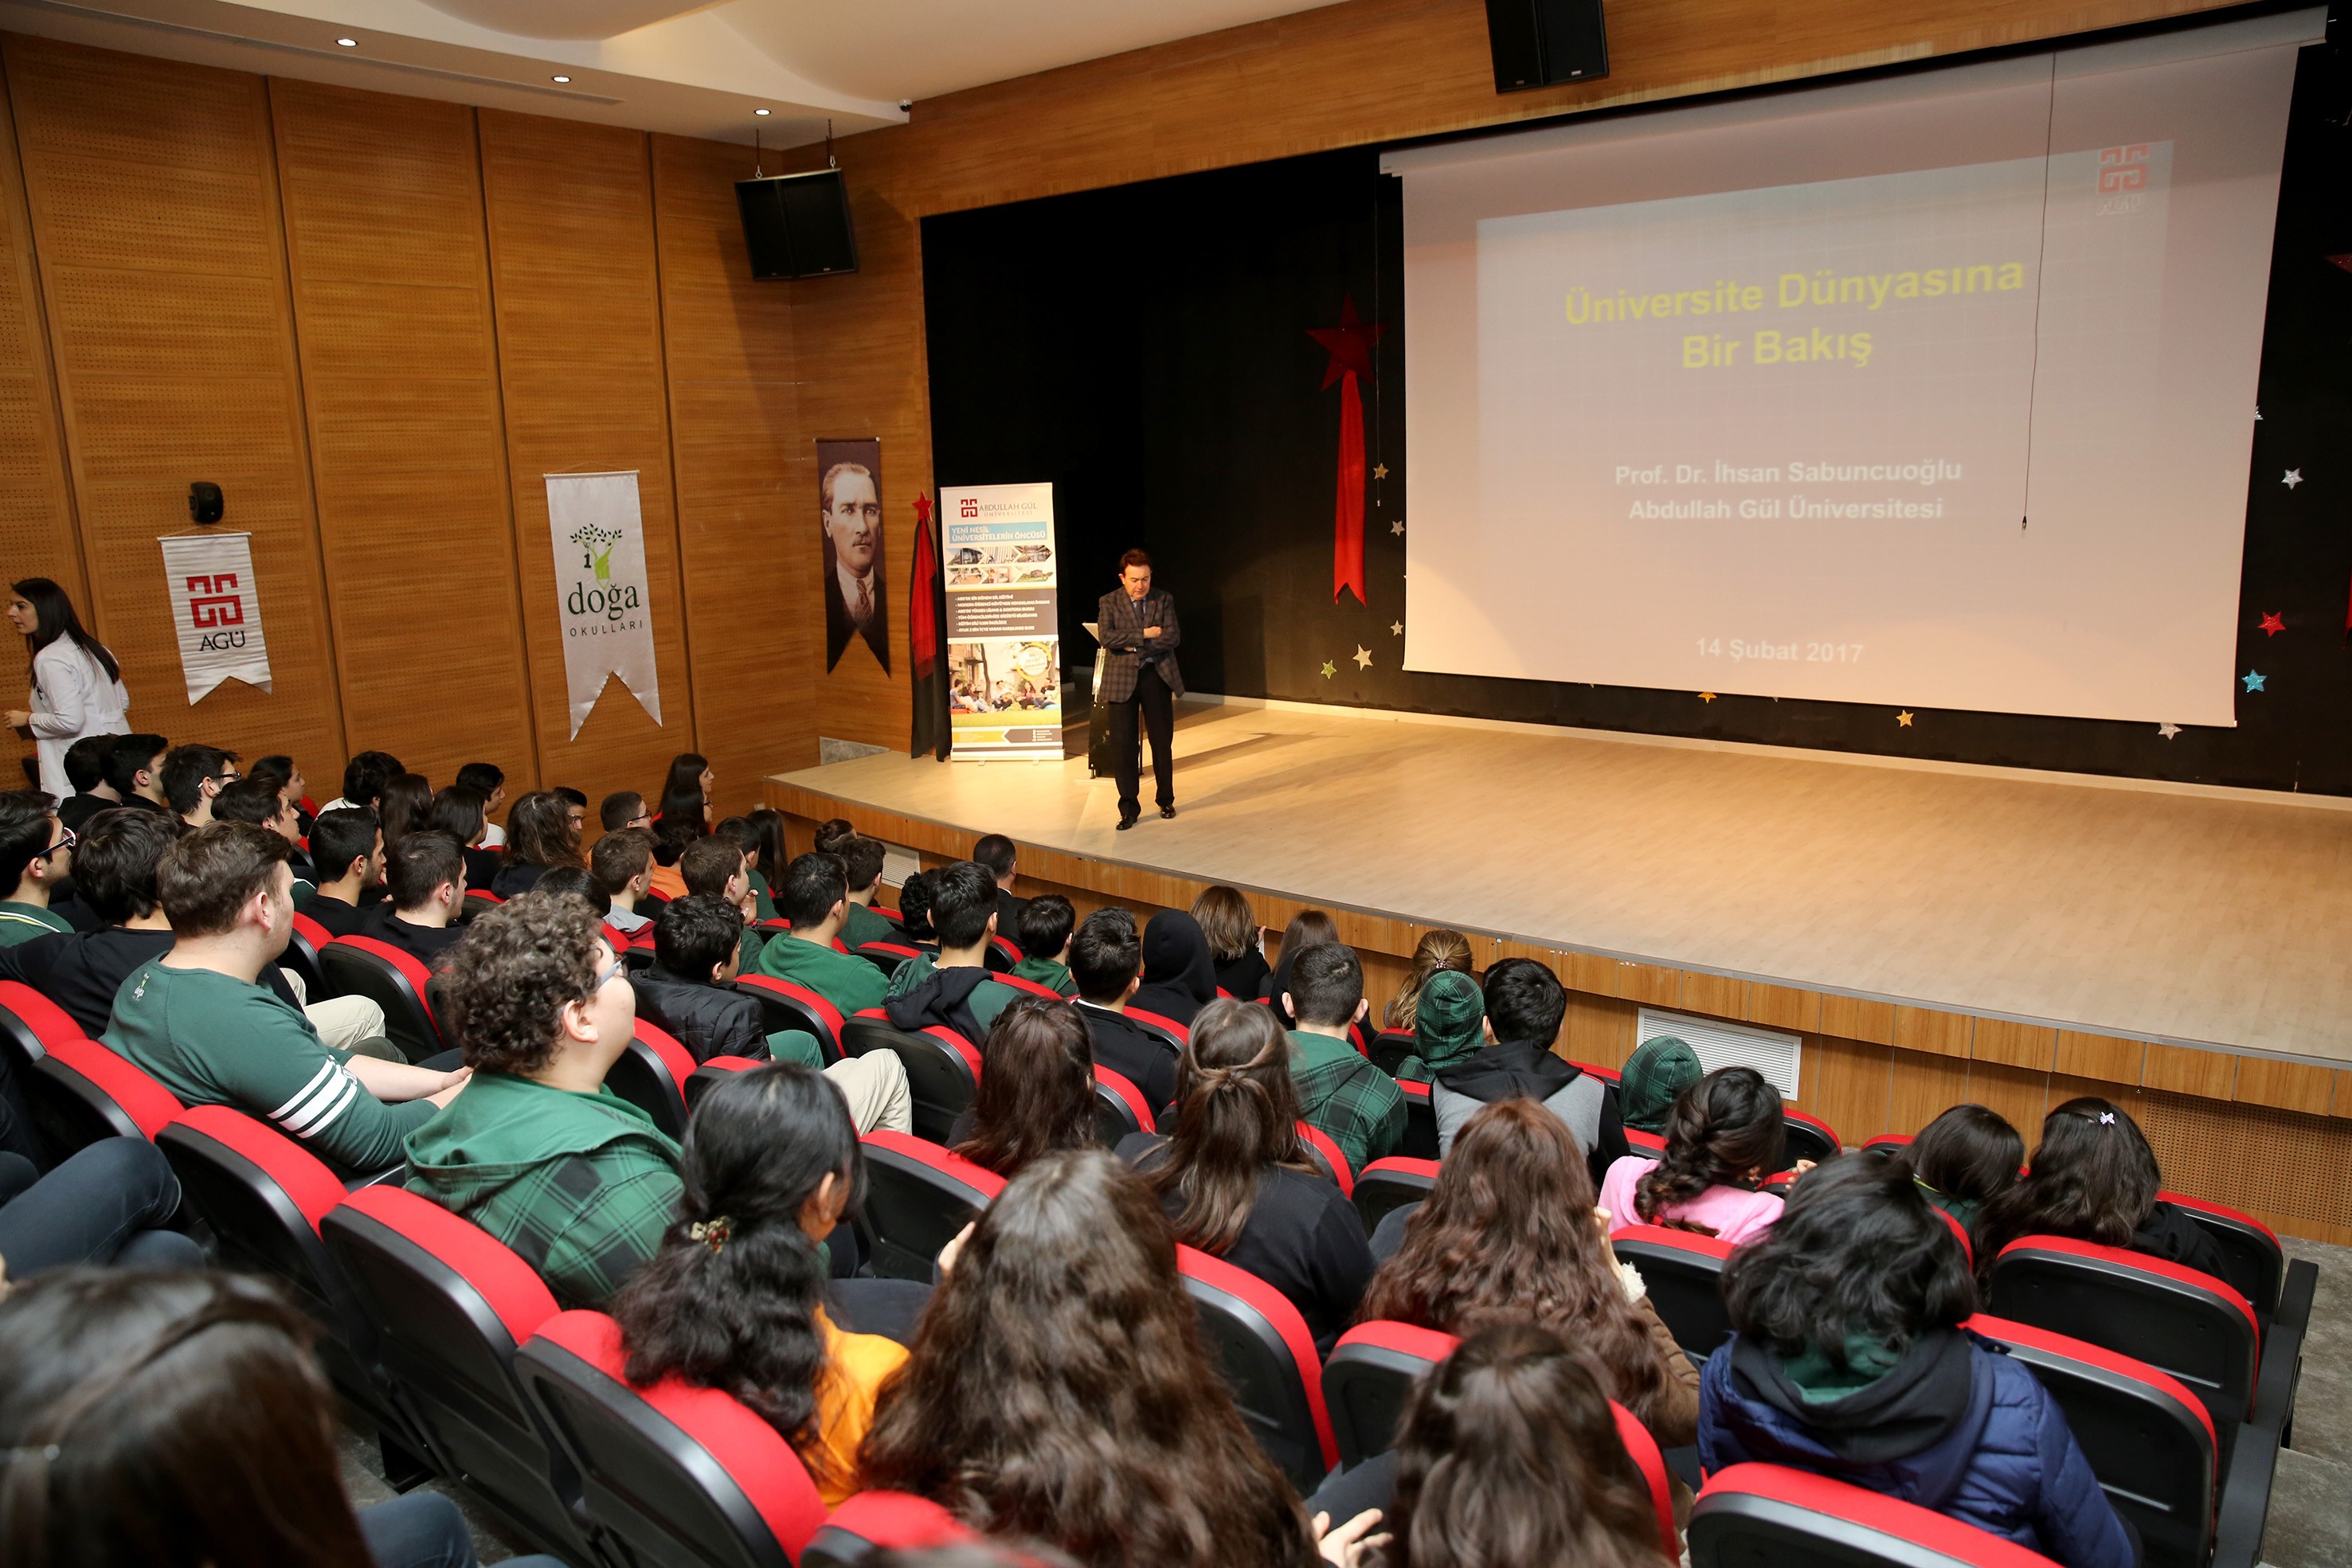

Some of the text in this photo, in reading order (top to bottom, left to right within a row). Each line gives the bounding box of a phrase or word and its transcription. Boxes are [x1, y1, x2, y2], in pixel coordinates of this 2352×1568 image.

[1565, 261, 2025, 325] Üniversite Dünyasına
[1682, 327, 1873, 369] Bir Bakış
[1615, 459, 1962, 486] Prof. Dr. İhsan Sabuncuoğlu
[1629, 495, 1943, 519] Abdullah Gül Üniversitesi
[951, 525, 989, 534] YENİ NESİL
[567, 581, 640, 620] doğa
[198, 631, 246, 651] AGÜ
[569, 620, 644, 638] OKULLARI
[1696, 638, 1865, 663] 14 Şubat 2017
